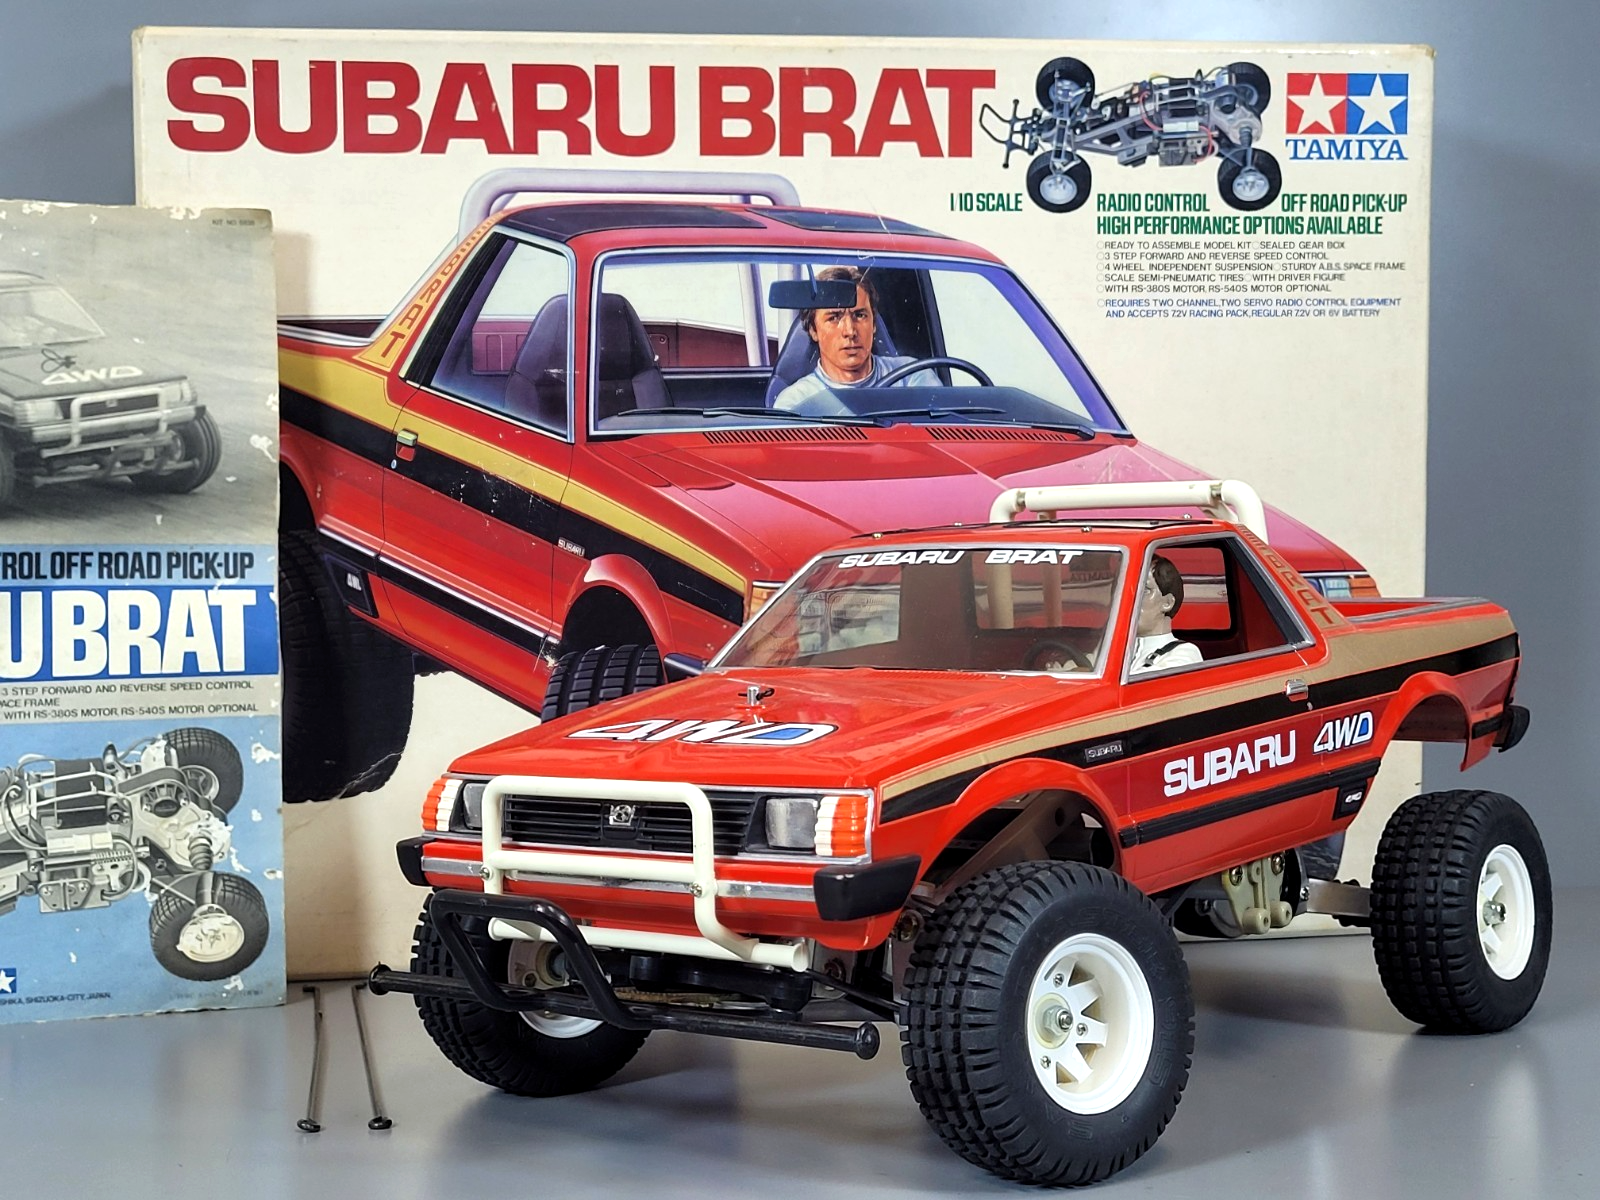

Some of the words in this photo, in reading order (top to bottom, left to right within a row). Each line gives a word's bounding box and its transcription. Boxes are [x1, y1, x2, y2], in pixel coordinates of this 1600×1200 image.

[167, 57, 675, 157] SUBARU
[700, 66, 996, 157] BRAT
[1285, 139, 1409, 161] TAMIYA
[976, 193, 1023, 212] SCALE
[1097, 193, 1142, 212] RADIO
[1145, 193, 1210, 212] CONTROL
[1281, 193, 1308, 212] OFF
[1310, 193, 1349, 212] ROAD
[1352, 193, 1408, 212] PICK-UP
[1097, 216, 1131, 235] HIGH
[1134, 216, 1240, 235] PERFORMANCE
[1243, 216, 1304, 235] OPTIONS
[1306, 216, 1383, 235] AVAILABLE
[1104, 241, 1134, 249] READY
[1138, 241, 1149, 249] TO
[1152, 241, 1200, 249] ASSEMBLE
[1204, 241, 1235, 249] MODEL
[1237, 241, 1252, 249] KIT
[1260, 241, 1295, 249] SEALED
[1299, 241, 1324, 249] GEAR
[1327, 241, 1345, 249] BOX
[1104, 252, 1110, 260] 3
[1113, 252, 1137, 260] STEP
[1140, 252, 1184, 260] FORWARD
[1187, 252, 1206, 260] AND
[1209, 252, 1250, 260] REVERSE
[1253, 252, 1282, 260] SPEED
[1285, 252, 1328, 260] CONTROL
[1105, 263, 1110, 271] 4
[1113, 263, 1144, 271] WHEEL
[1149, 263, 1212, 271] INDEPENDENT
[1215, 263, 1273, 271] SUSPENSION
[1281, 263, 1316, 271] STURDY
[1344, 263, 1372, 271] SPACE
[1374, 263, 1405, 271] FRAME
[1104, 274, 1134, 282] SCALE
[1138, 274, 1216, 282] SEMI-PNEUMATIC
[1219, 274, 1244, 282] TIRES
[1253, 274, 1275, 282] WITH
[1278, 274, 1311, 282] DRIVER
[1313, 274, 1345, 282] FIGURE
[1105, 285, 1128, 293] WITH
[1131, 285, 1170, 293] RS-380S
[1208, 285, 1248, 293] RS-540S
[1251, 285, 1282, 293] MOTOR
[1286, 285, 1331, 293] OPTIONAL
[1105, 299, 1150, 307] REQUIRES
[1153, 299, 1173, 307] TWO
[1244, 299, 1273, 307] SERVO
[1276, 299, 1302, 307] RADIO
[1305, 299, 1348, 307] CONTROL
[1351, 299, 1401, 307] EQUIPMENT
[1106, 310, 1125, 318] AND
[1127, 310, 1169, 318] ACCEPTS
[1190, 310, 1223, 318] RACING
[1313, 310, 1325, 318] OR
[1342, 310, 1380, 318] BATTERY
[558, 539, 585, 557] SUBARU
[0, 552, 47, 579] ROL
[51, 552, 94, 579] OFF
[99, 552, 162, 579] ROAD
[167, 551, 254, 579] PICK-UP
[838, 550, 965, 569] SUBARU
[984, 550, 1083, 565] BRAT
[52, 589, 256, 677] BRAT
[2, 688, 8, 696] 3
[12, 687, 38, 696] STEP
[42, 685, 92, 695] FORWARD
[95, 684, 117, 693] AND
[120, 683, 166, 692] REVERSE
[170, 682, 202, 691] SPEED
[206, 681, 254, 690] CONTROL
[24, 698, 60, 707] FRAME
[4, 711, 30, 719] WITH
[34, 709, 78, 718] RS-380S
[121, 706, 165, 716] RS-540S
[168, 705, 204, 714] MOTOR
[208, 704, 258, 713] OPTIONAL
[568, 719, 839, 746] 4WD
[1087, 743, 1122, 758] SUBARU
[1163, 729, 1297, 797] SUBARU
[1312, 711, 1374, 754] 4WD
